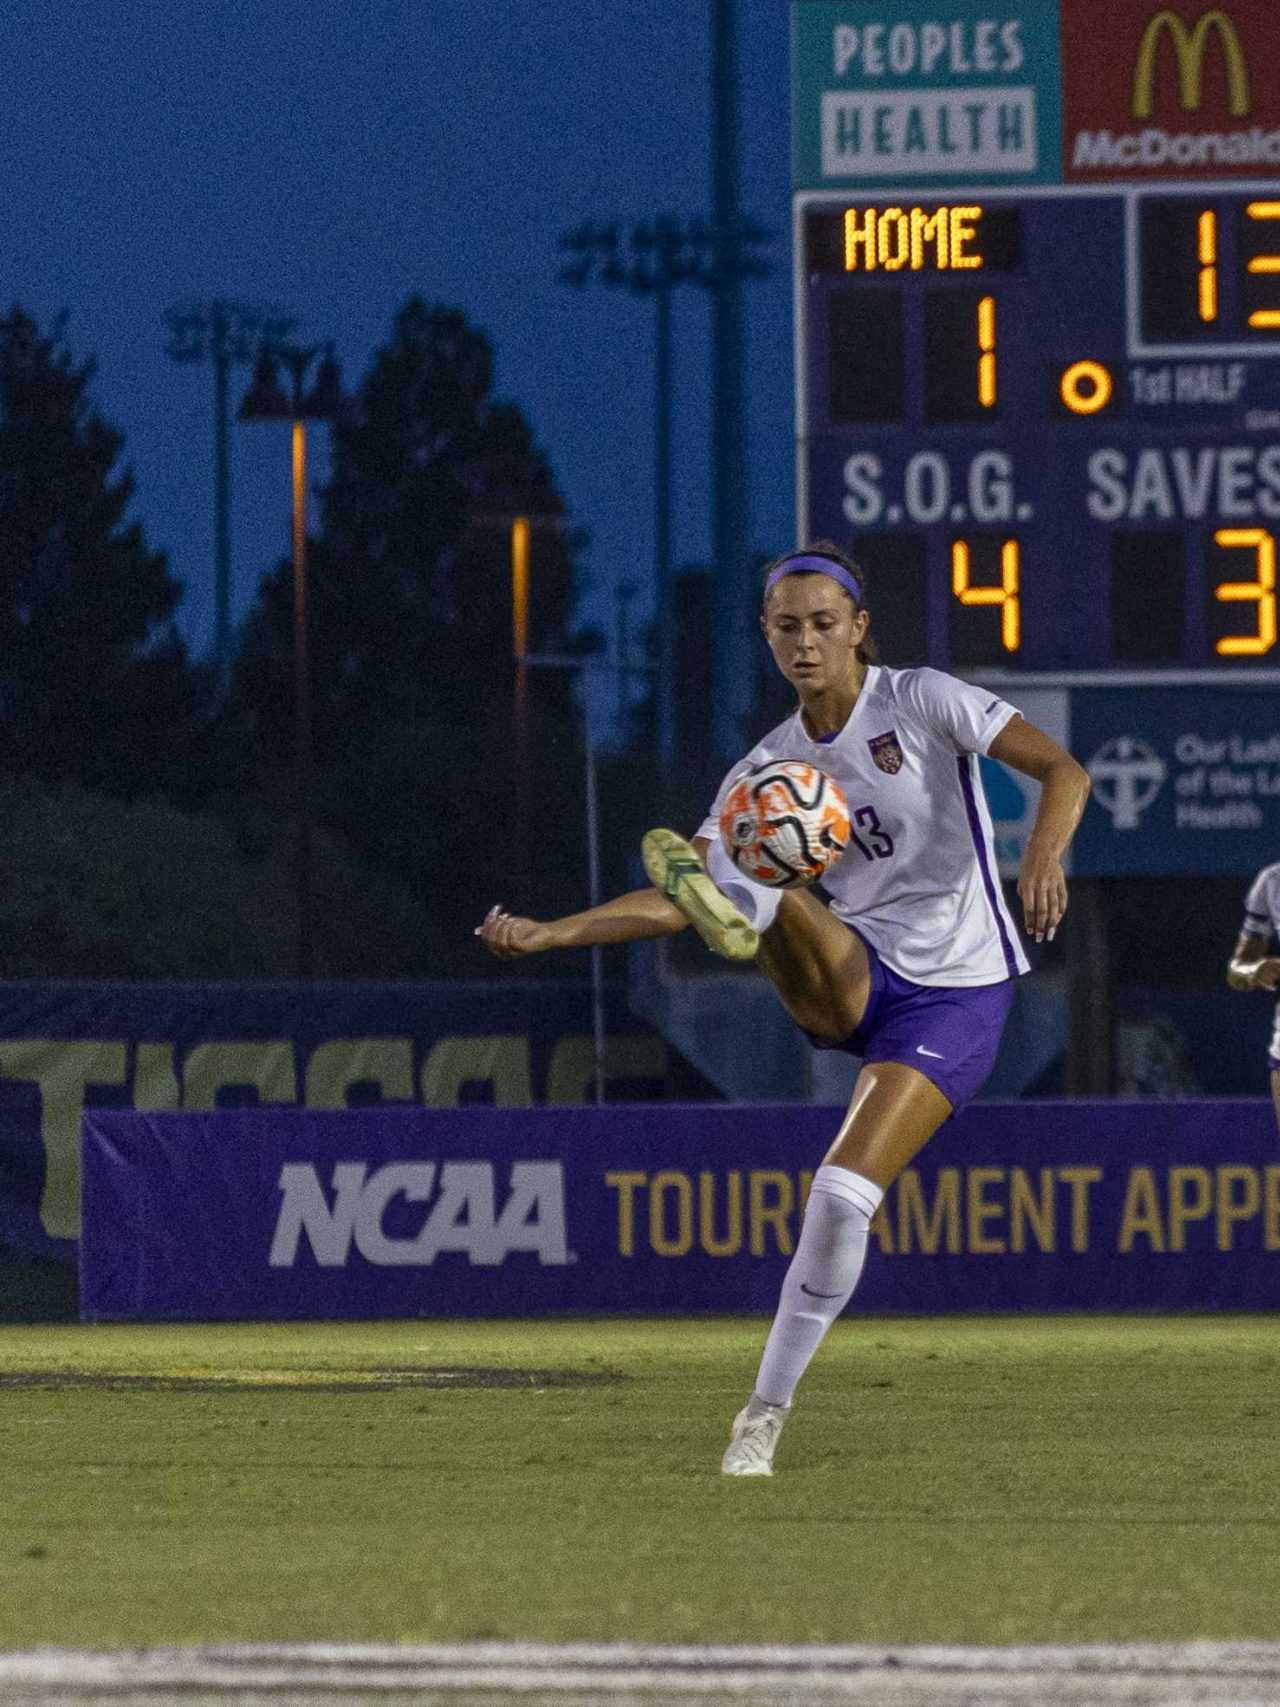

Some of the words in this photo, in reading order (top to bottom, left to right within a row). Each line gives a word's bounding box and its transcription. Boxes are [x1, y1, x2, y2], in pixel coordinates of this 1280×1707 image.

[833, 20, 1023, 75] PEOPLES
[836, 100, 1024, 155] HEALTH
[844, 206, 983, 271] HOME
[976, 296, 997, 408] 1
[1128, 366, 1171, 402] 1st
[1175, 363, 1246, 402] HALF
[842, 451, 1033, 524] S.O.G.
[951, 539, 1021, 652] 4
[1214, 527, 1278, 656] 3
[1174, 734, 1227, 764] Our
[1209, 768, 1251, 796] the
[850, 804, 895, 862] 13
[268, 1160, 570, 1267] NCAA
